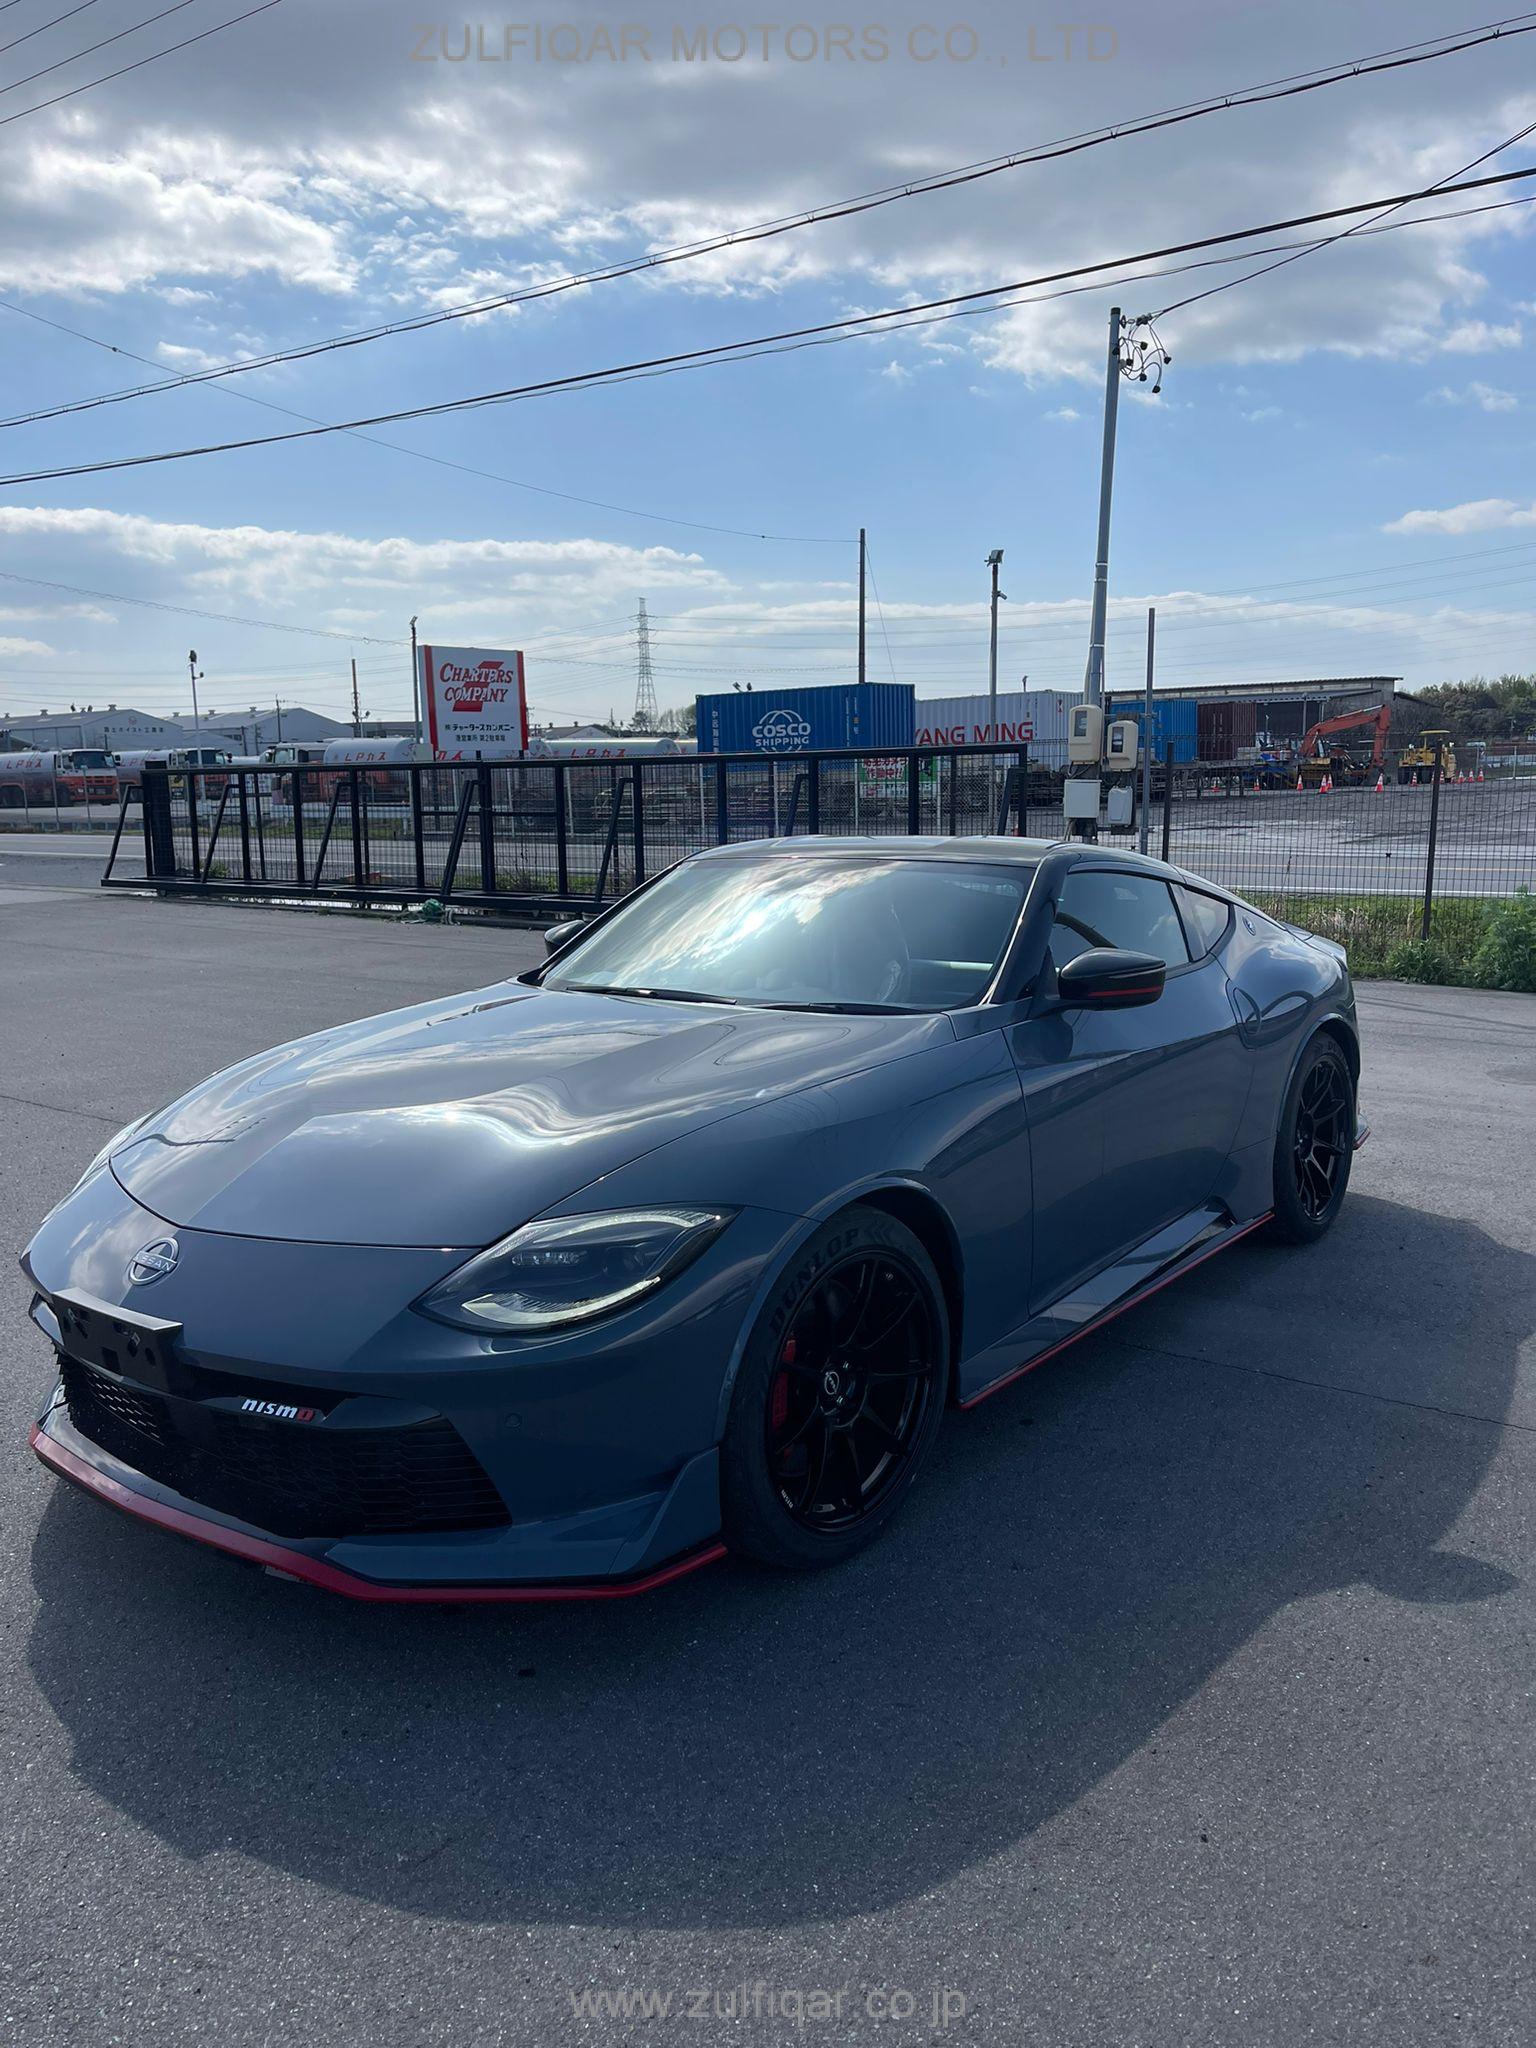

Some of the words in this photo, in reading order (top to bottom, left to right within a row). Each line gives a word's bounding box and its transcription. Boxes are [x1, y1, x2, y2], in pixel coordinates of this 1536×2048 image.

[440, 662, 514, 684] CHARTERS
[444, 686, 509, 703] COMPANY
[752, 722, 811, 738] COSCO
[973, 721, 1034, 743] MING
[755, 736, 809, 747] SHIPPING
